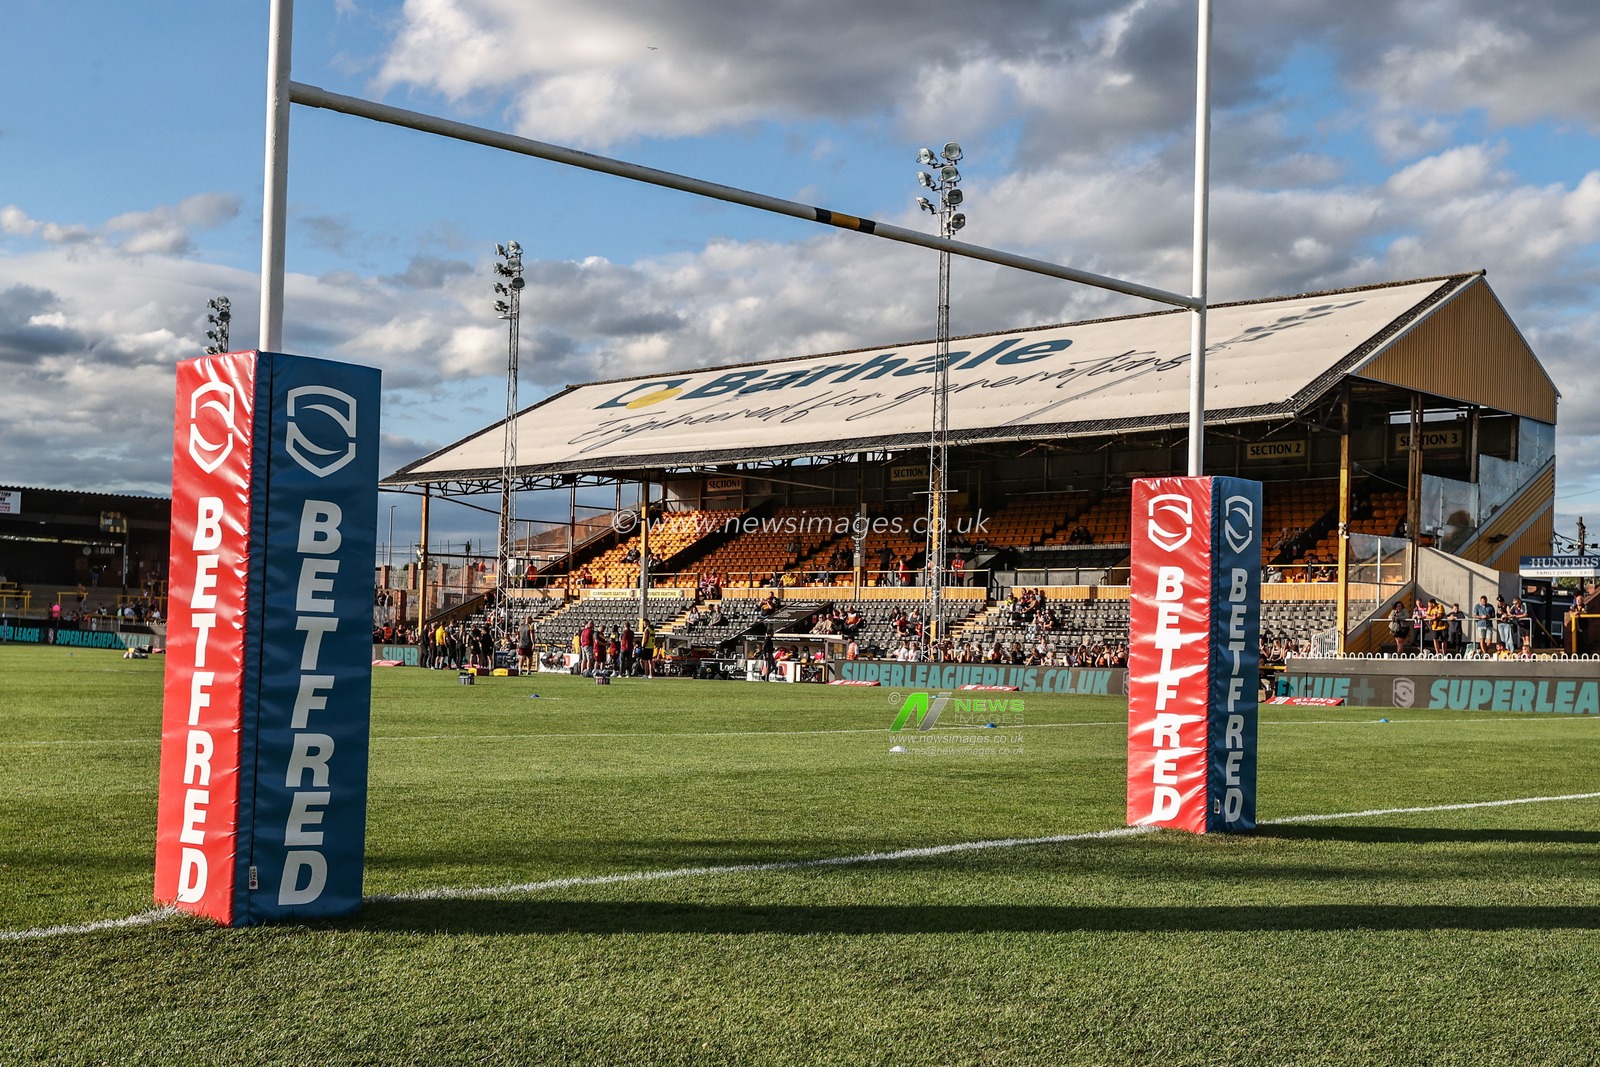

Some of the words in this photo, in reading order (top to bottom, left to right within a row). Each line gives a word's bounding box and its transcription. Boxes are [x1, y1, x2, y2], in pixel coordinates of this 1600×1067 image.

[675, 337, 1074, 401] Barhale
[780, 388, 887, 423] for
[845, 349, 1186, 421] generations
[1250, 444, 1292, 456] SECTION
[1295, 443, 1301, 453] 2
[1400, 434, 1447, 447] SETION
[1451, 433, 1458, 444] 3
[708, 480, 736, 489] SECTION
[893, 468, 923, 478] SECTION
[1529, 557, 1599, 568] HUNTERS
[382, 646, 419, 666] SUPER
[841, 662, 1112, 695] SUPERLEAGUEPLUS.CO.UK
[1149, 566, 1185, 822] BETFRED
[1224, 567, 1248, 823] BETFRED
[176, 496, 224, 904] BETFRED
[277, 499, 343, 906] BETFRED
[1428, 678, 1600, 714] SUPERLEA
